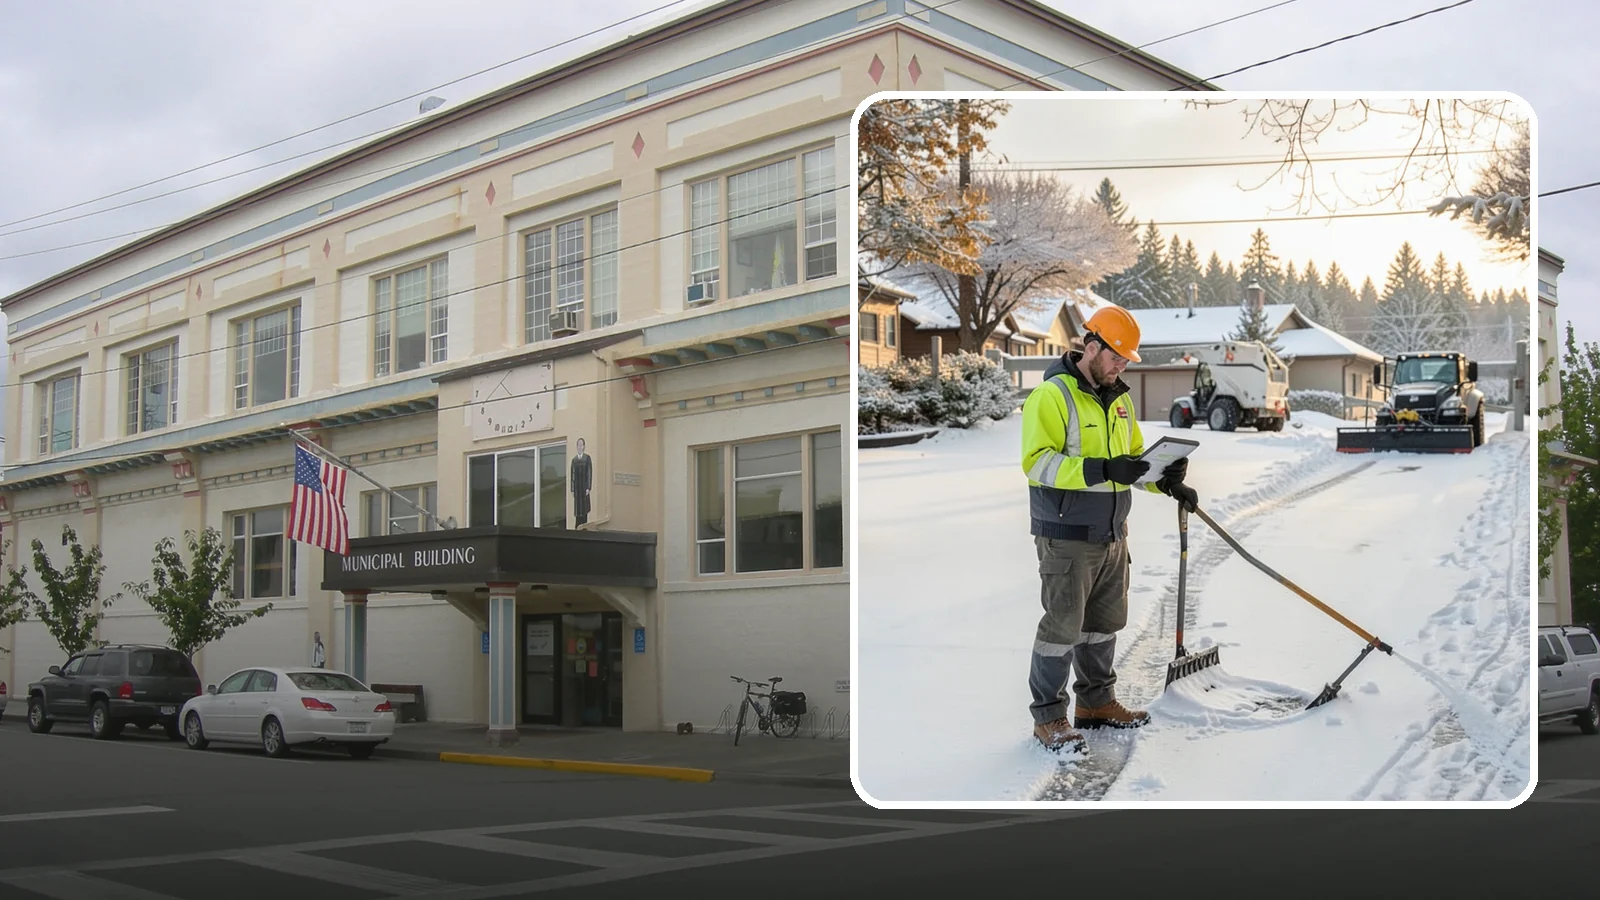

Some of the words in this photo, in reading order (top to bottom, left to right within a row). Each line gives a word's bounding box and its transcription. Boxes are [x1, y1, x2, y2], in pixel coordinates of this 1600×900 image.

[494, 423, 500, 432] 10
[342, 552, 405, 572] MUNICIPAL
[414, 546, 475, 567] BUILDING
